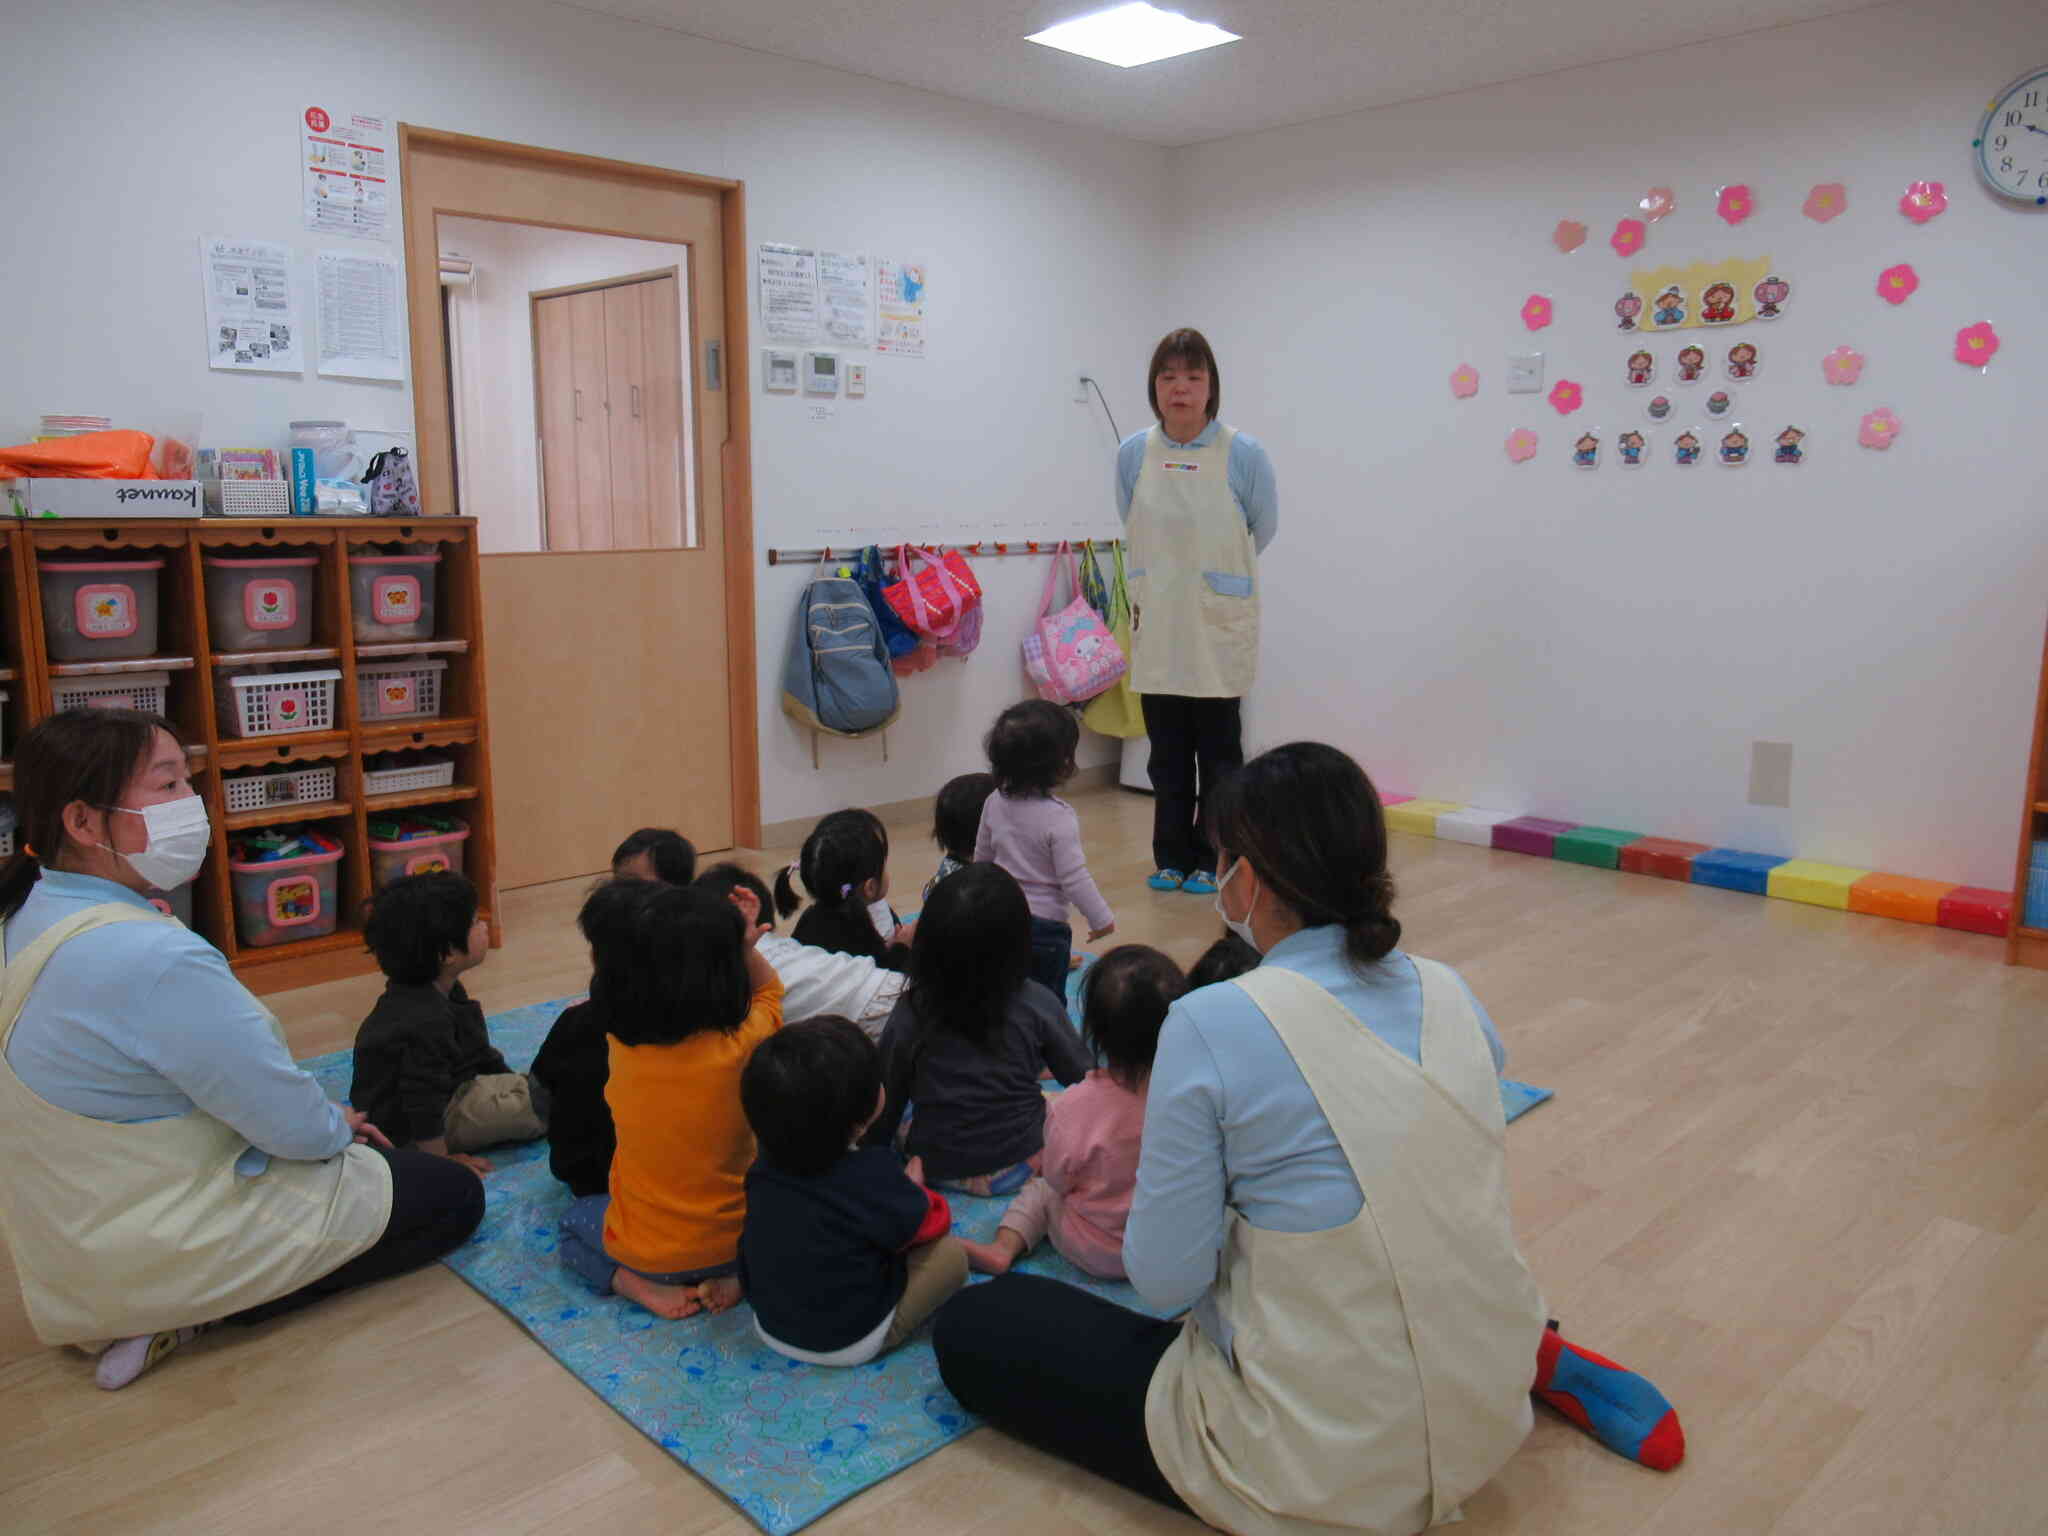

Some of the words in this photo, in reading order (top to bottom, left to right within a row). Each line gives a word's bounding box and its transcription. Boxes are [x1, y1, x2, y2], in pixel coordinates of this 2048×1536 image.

[2024, 91, 2038, 108] 11
[2004, 110, 2022, 127] 10
[1994, 135, 2008, 152] 9
[2000, 156, 2013, 173] 8
[2016, 169, 2029, 186] 7
[116, 486, 197, 508] kaunet
